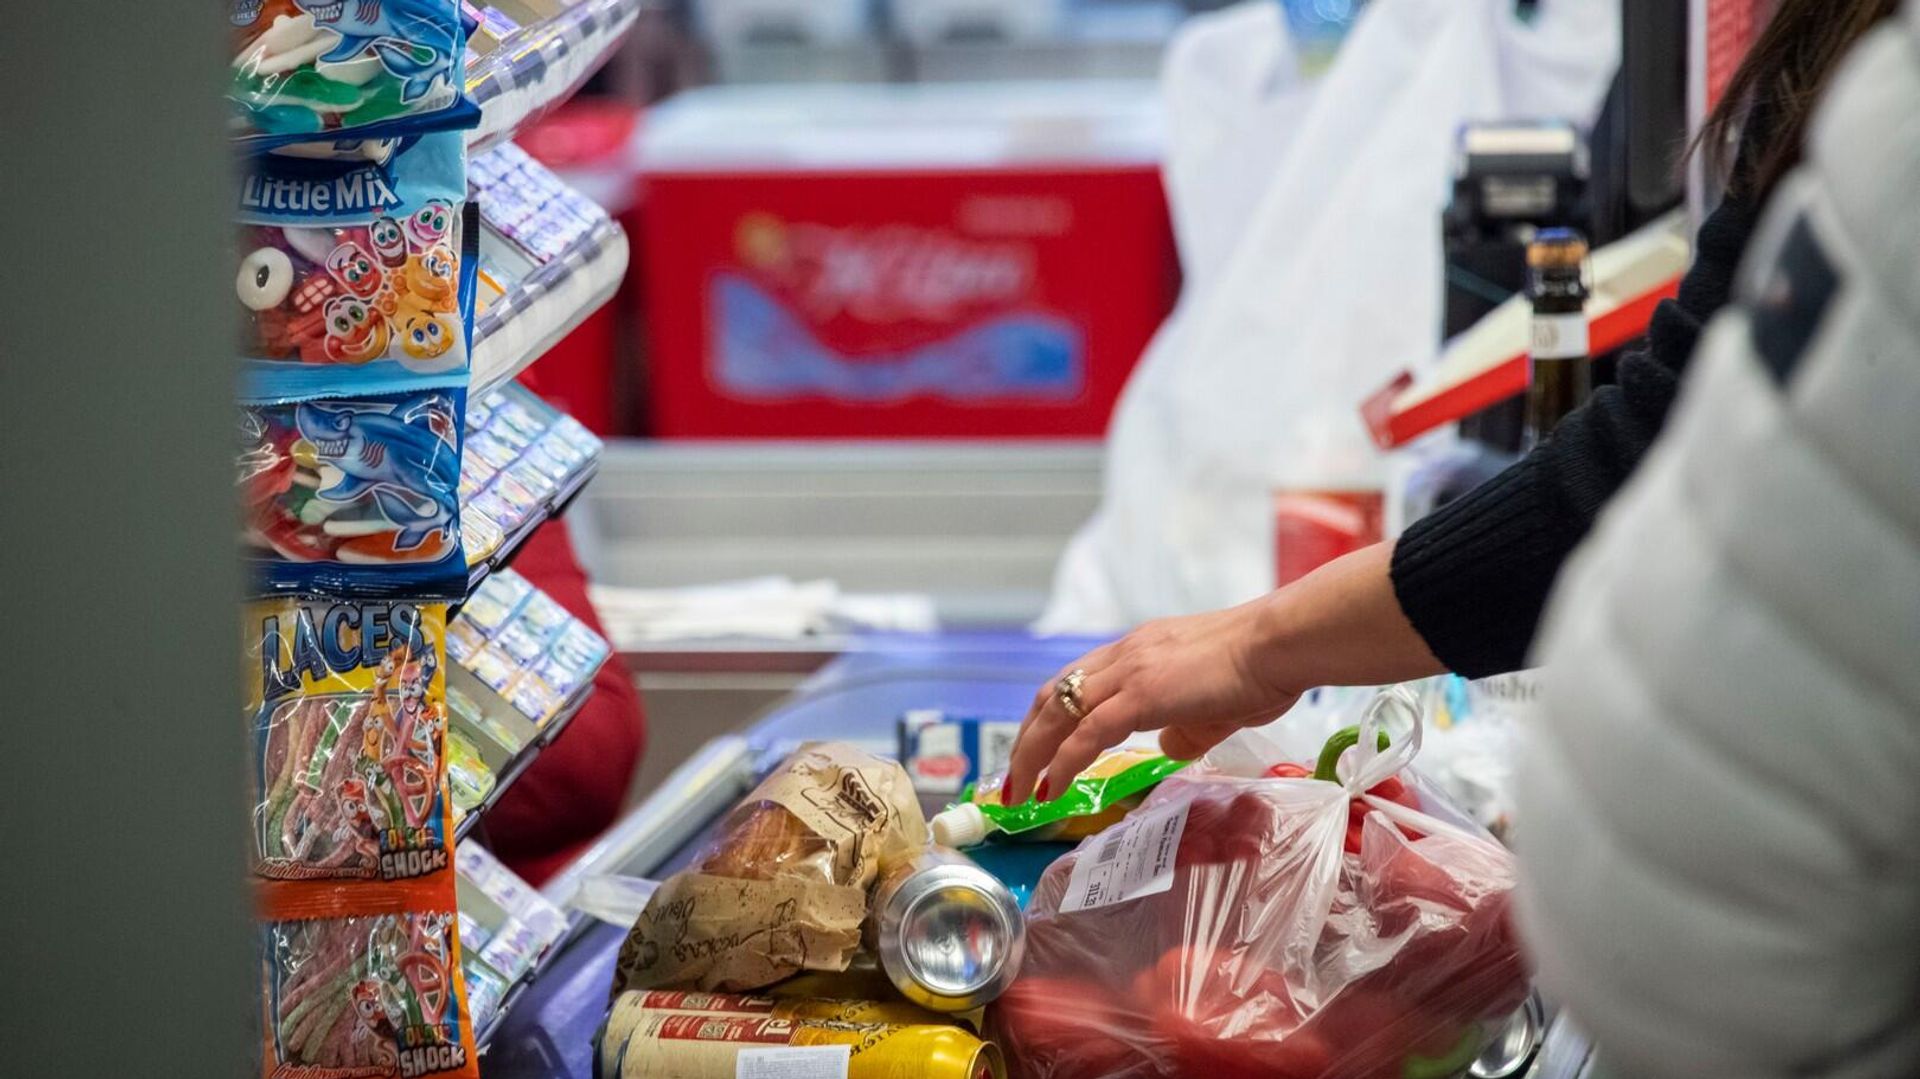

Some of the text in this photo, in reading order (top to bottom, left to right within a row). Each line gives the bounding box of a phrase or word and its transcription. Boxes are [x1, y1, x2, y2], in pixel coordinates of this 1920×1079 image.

[242, 171, 399, 211] Little Mix
[262, 603, 425, 698] LACES
[381, 849, 447, 880] SHOCK
[400, 1046, 465, 1078] SHOCK
